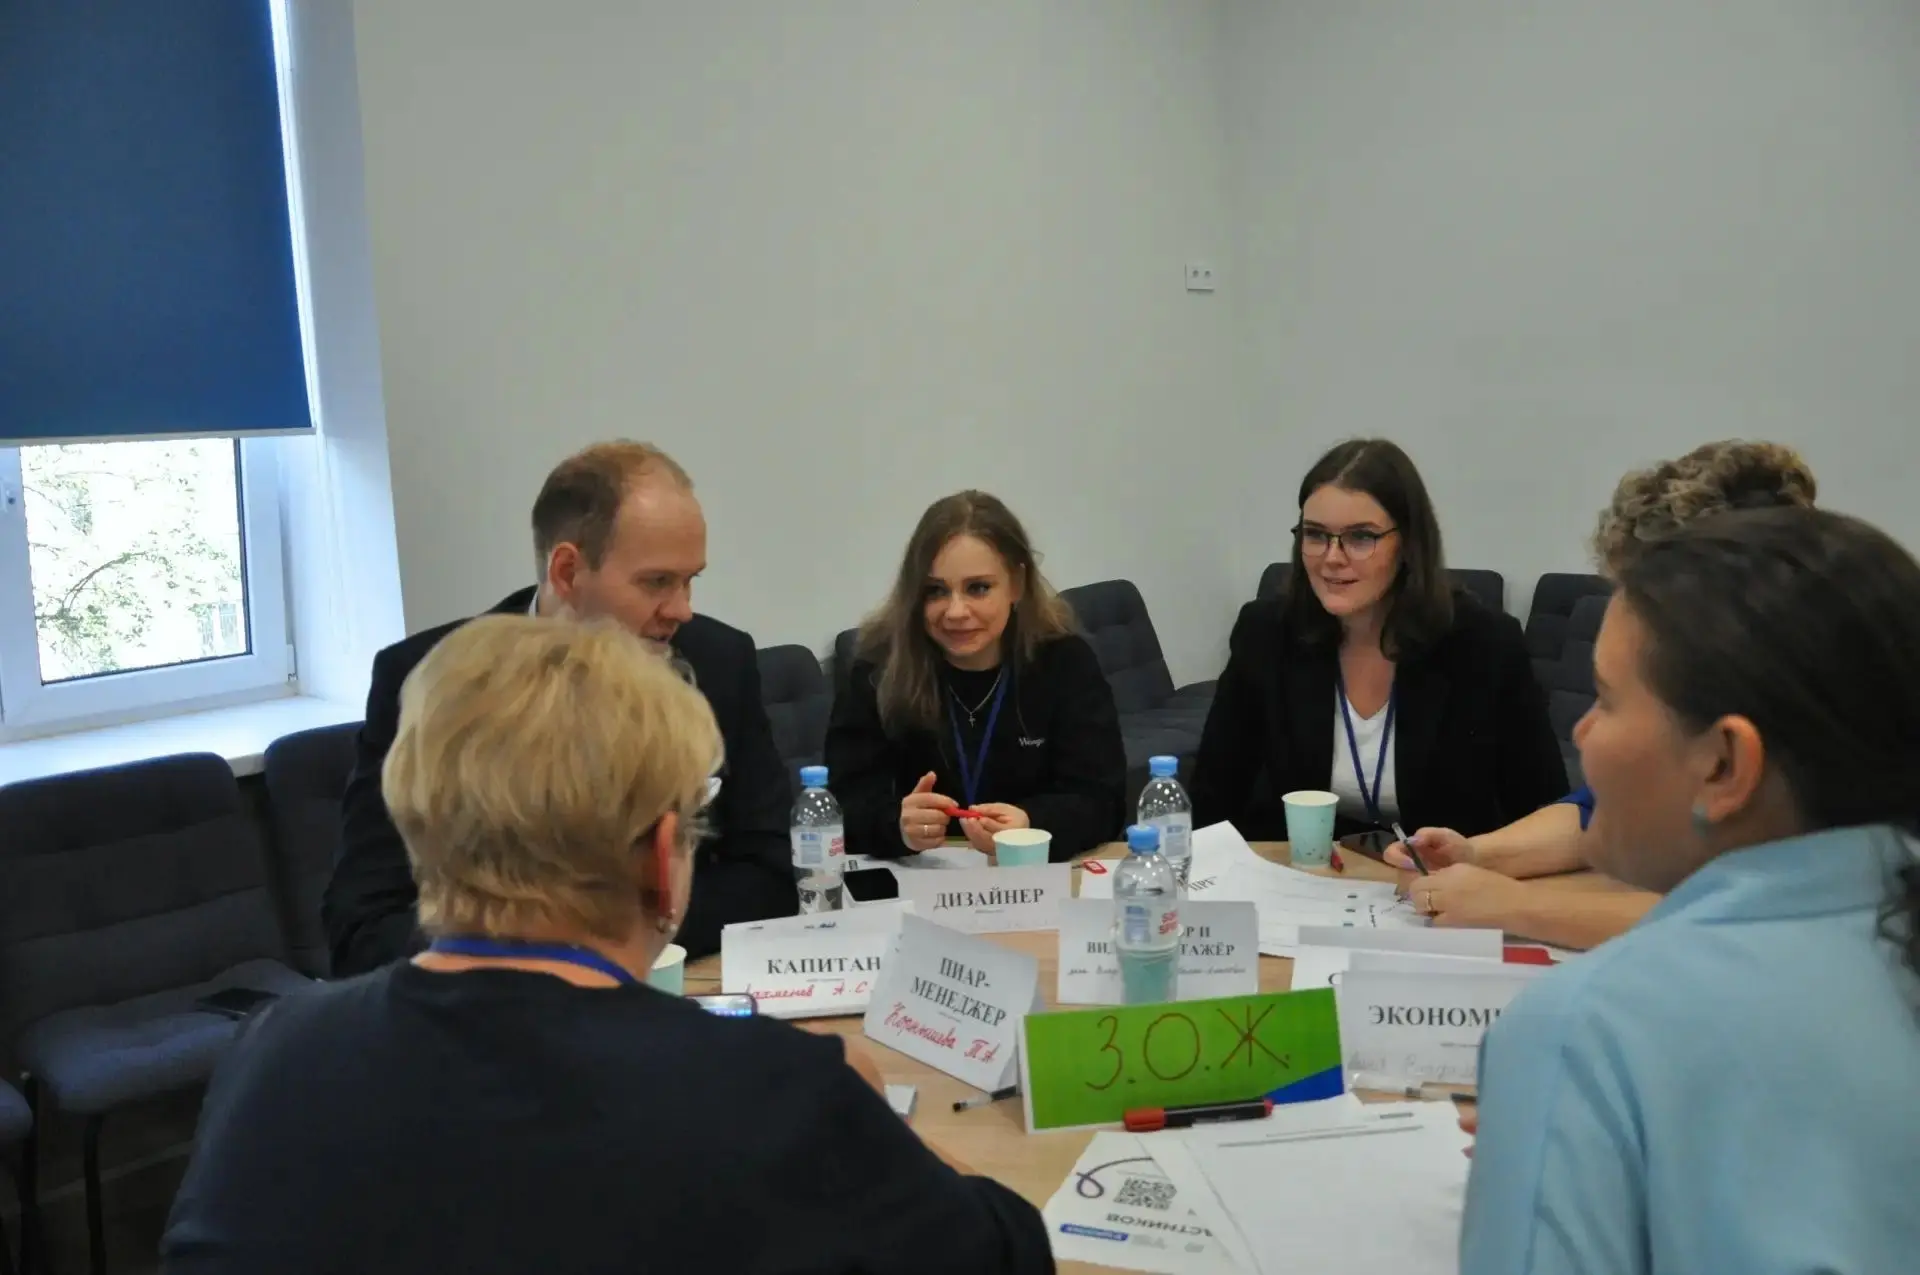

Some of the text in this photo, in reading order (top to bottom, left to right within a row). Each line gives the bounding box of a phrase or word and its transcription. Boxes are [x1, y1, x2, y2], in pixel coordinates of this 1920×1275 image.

[932, 887, 1045, 910] ДИЗАЙНЕР
[1086, 941, 1236, 957] ВИТАЖЁР
[767, 956, 881, 974] КАПИТАН
[939, 957, 991, 988] ПИАР-
[909, 976, 1007, 1027] МЕНЕДЖЕР
[1085, 1002, 1291, 1091] З.О.Ж.
